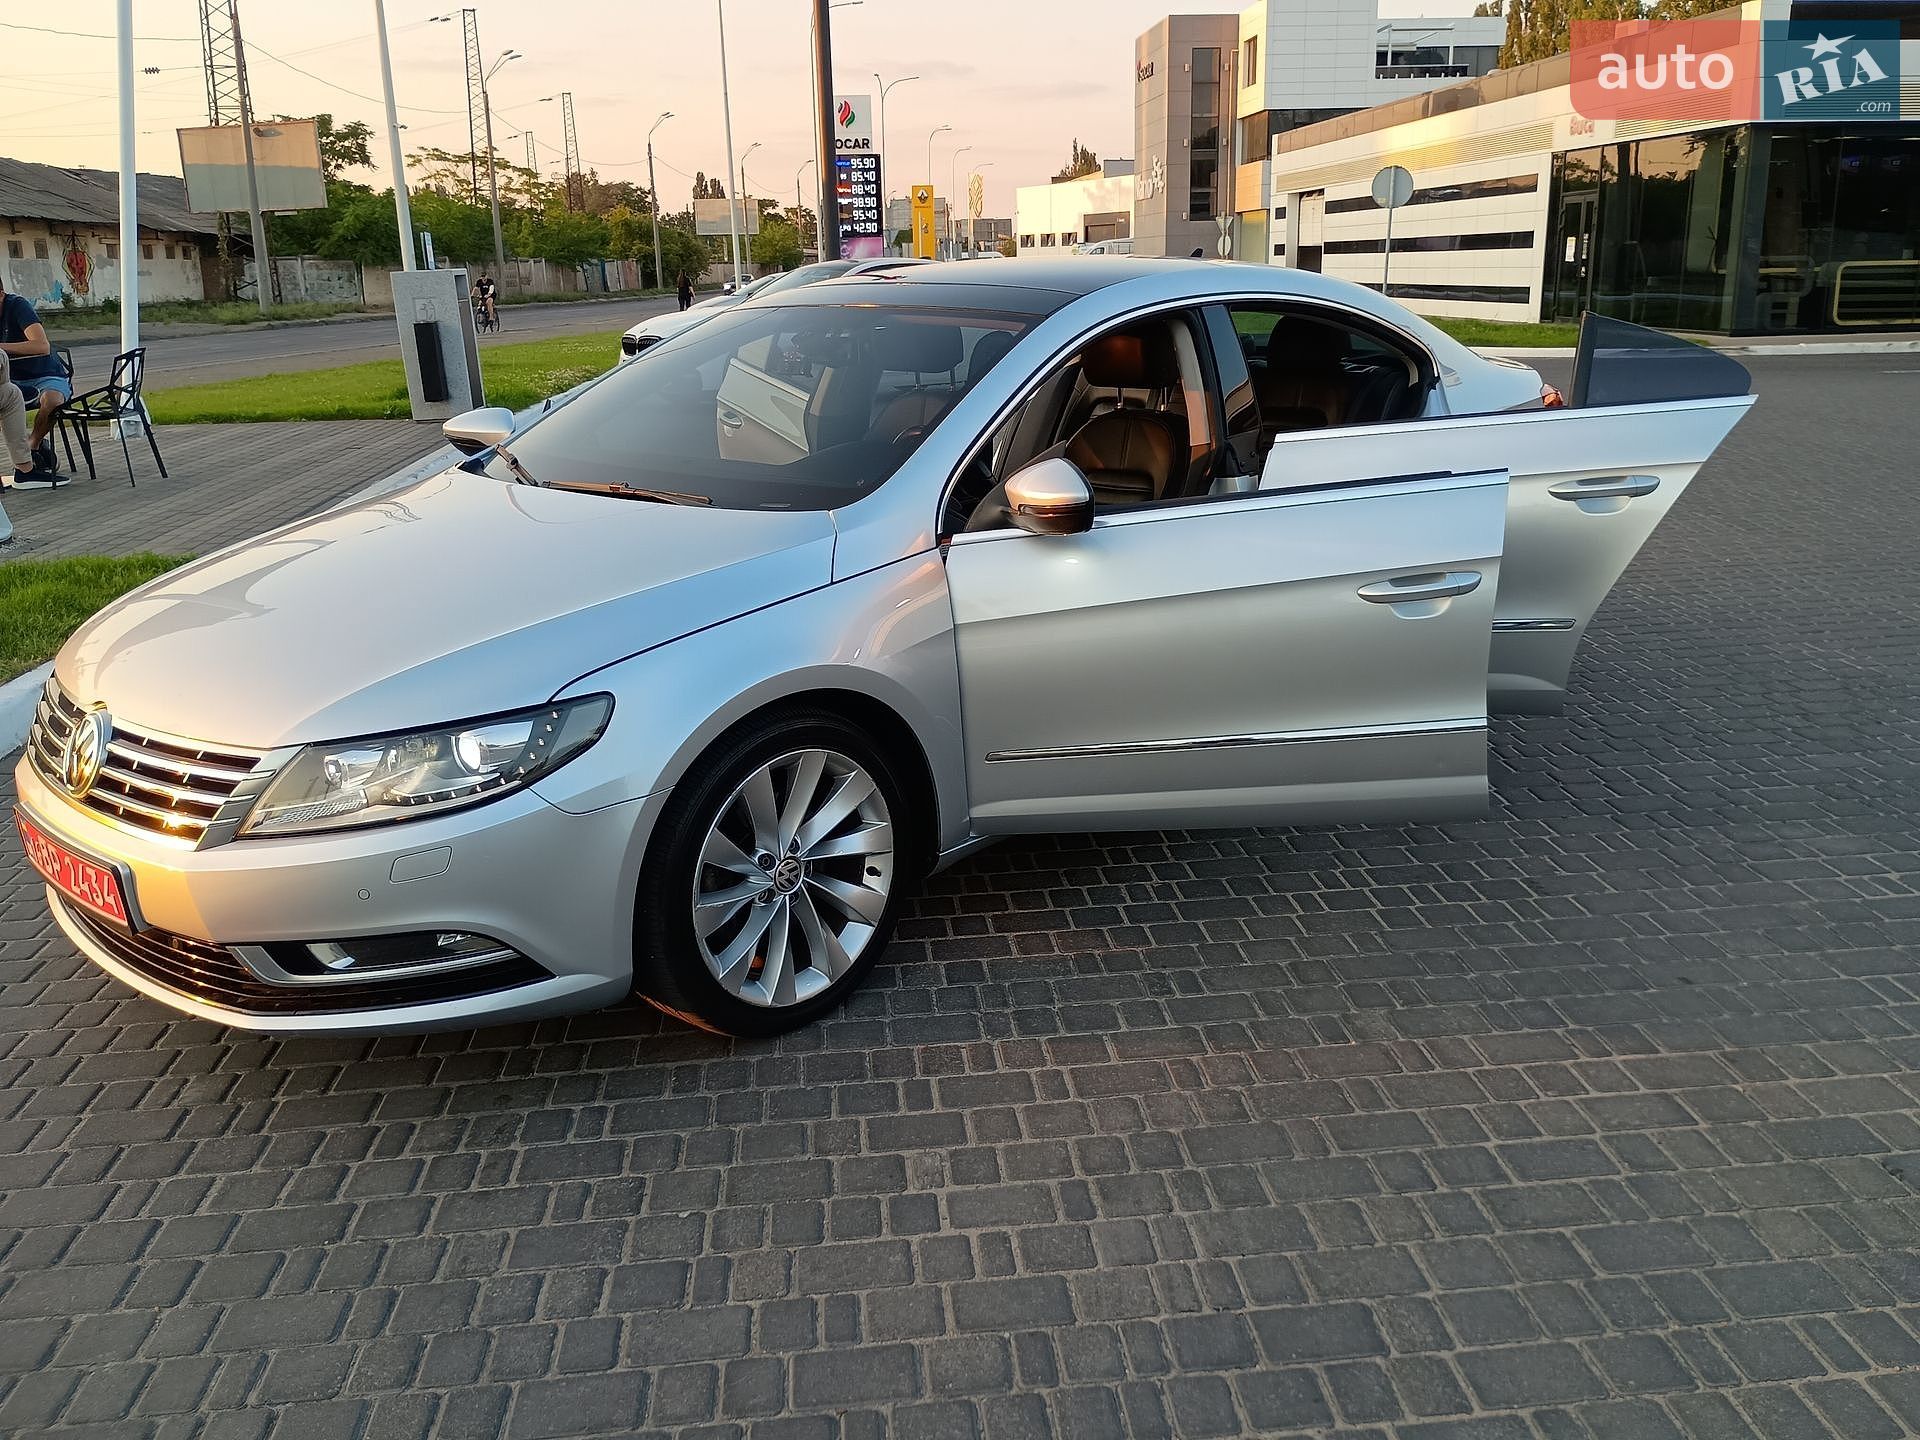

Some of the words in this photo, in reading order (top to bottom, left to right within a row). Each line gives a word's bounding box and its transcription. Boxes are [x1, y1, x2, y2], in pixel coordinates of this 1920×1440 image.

[836, 138, 870, 149] OCAR
[851, 158, 876, 168] 95.90
[851, 171, 876, 182] 85.40
[852, 184, 877, 195] 88.40
[852, 210, 878, 221] 95.40
[853, 223, 878, 233] 42.90
[64, 855, 120, 916] 2434
